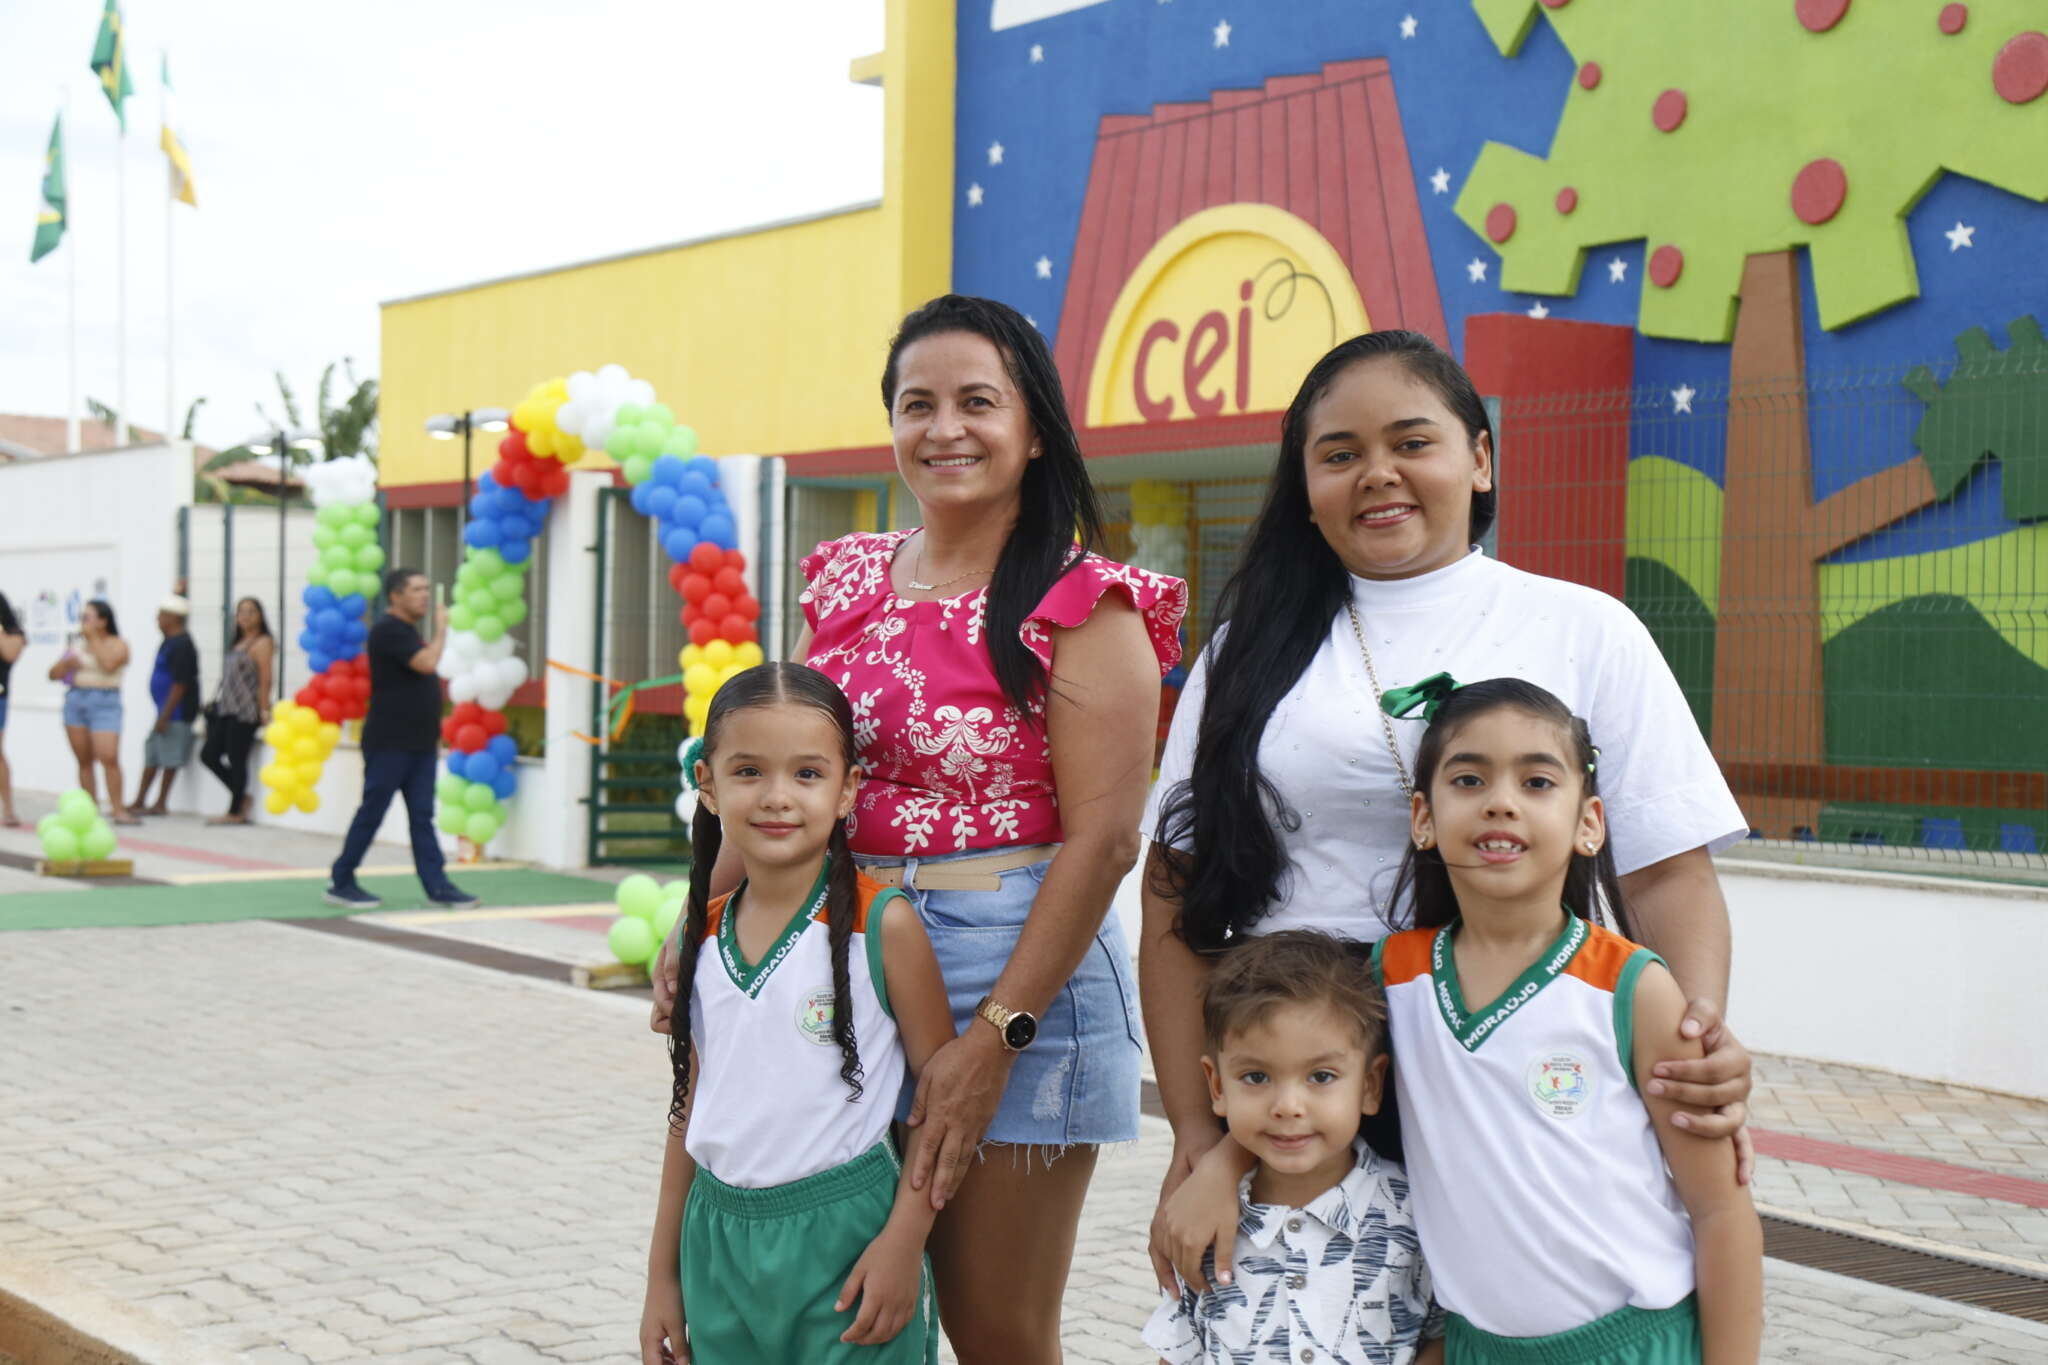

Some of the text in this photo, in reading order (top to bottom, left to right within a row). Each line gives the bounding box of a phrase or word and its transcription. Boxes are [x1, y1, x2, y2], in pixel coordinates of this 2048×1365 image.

[1133, 279, 1254, 422] cei
[744, 930, 801, 998] MORAÚJO
[1463, 982, 1538, 1049] MORAÚJO
